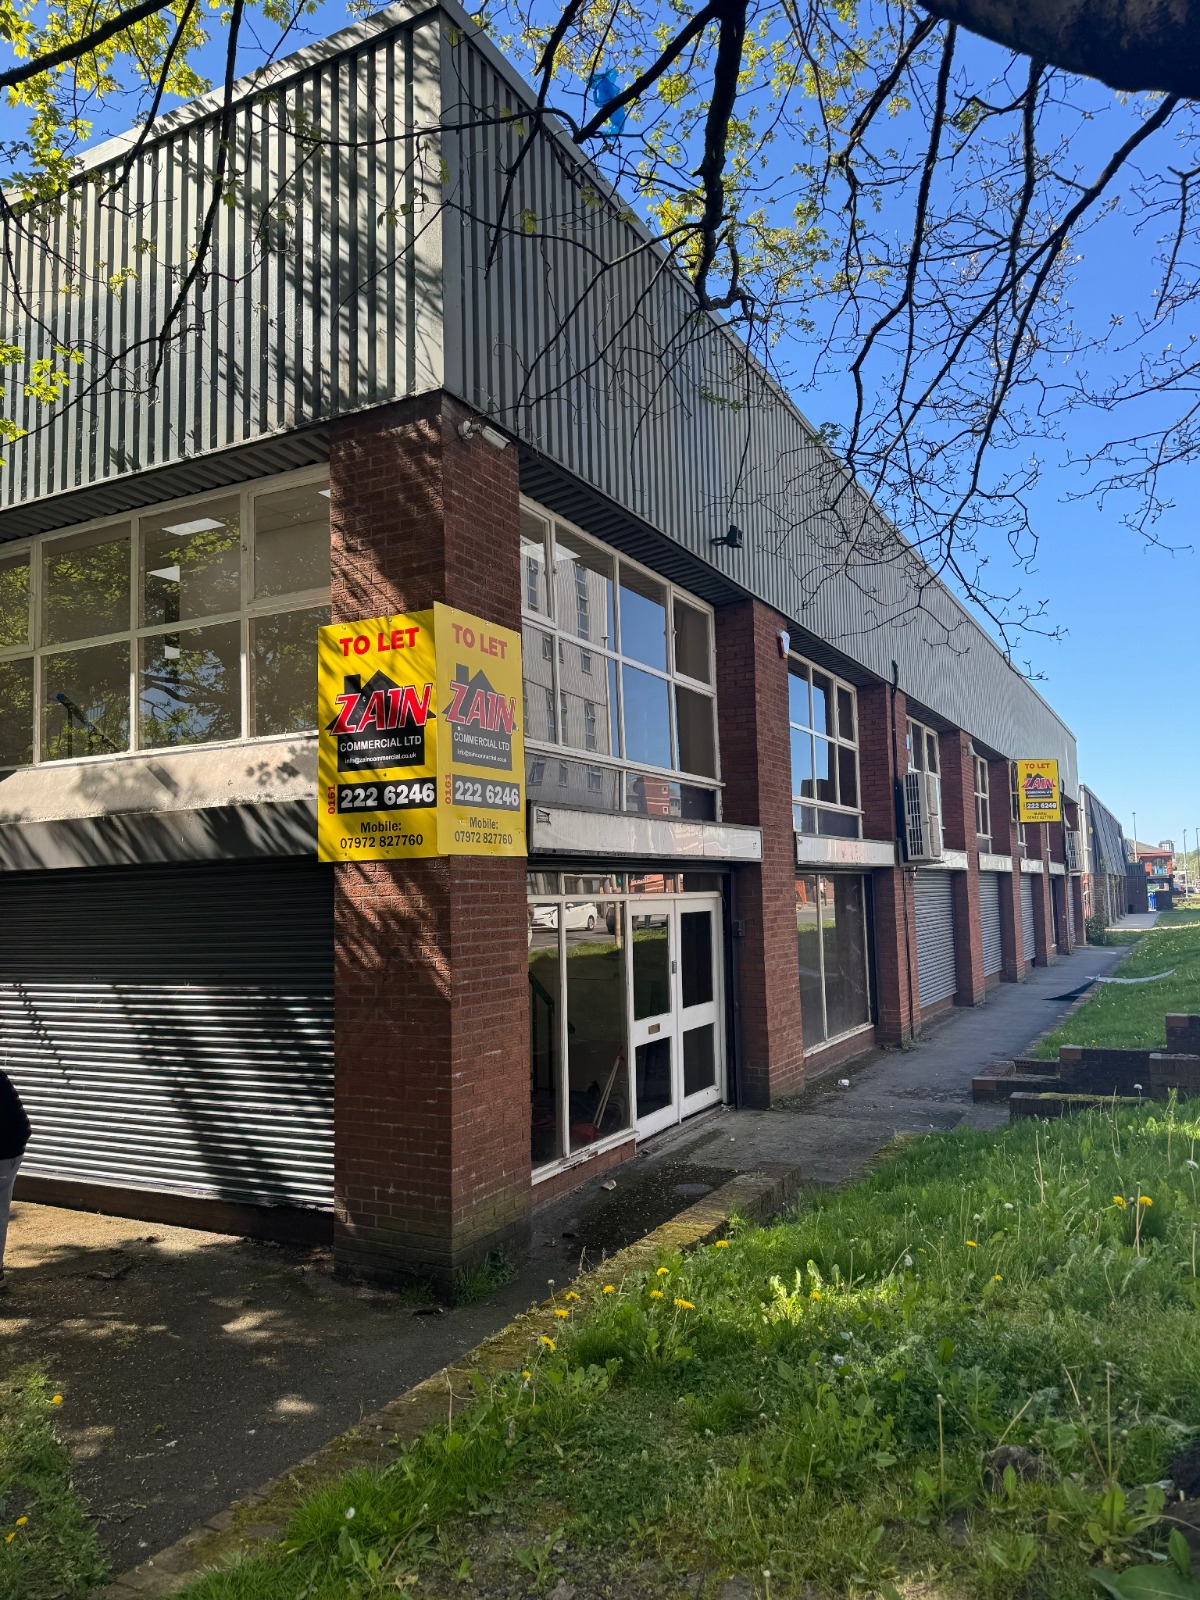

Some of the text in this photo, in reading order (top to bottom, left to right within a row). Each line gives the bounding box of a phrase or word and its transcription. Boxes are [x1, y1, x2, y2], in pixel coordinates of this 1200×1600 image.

[339, 626, 420, 657] TO LET
[451, 623, 508, 659] TO LET
[329, 682, 434, 737] ZAIN
[445, 680, 517, 735] ZAIN
[340, 735, 422, 752] COMMERCIAL LTD
[453, 732, 510, 751] COMMERCIAL LTD
[344, 752, 417, 765] info@zaincommercial.co.uk
[444, 772, 452, 805] 0161
[454, 780, 520, 807] 222 6246
[1024, 777, 1055, 789] ZAIN
[327, 784, 336, 815] 0161
[340, 782, 436, 808] 222 6246
[360, 820, 402, 833] Mobile:
[469, 816, 499, 830] Mobile:
[340, 834, 424, 849] 07972 827760
[454, 830, 513, 845] 07972 827760
